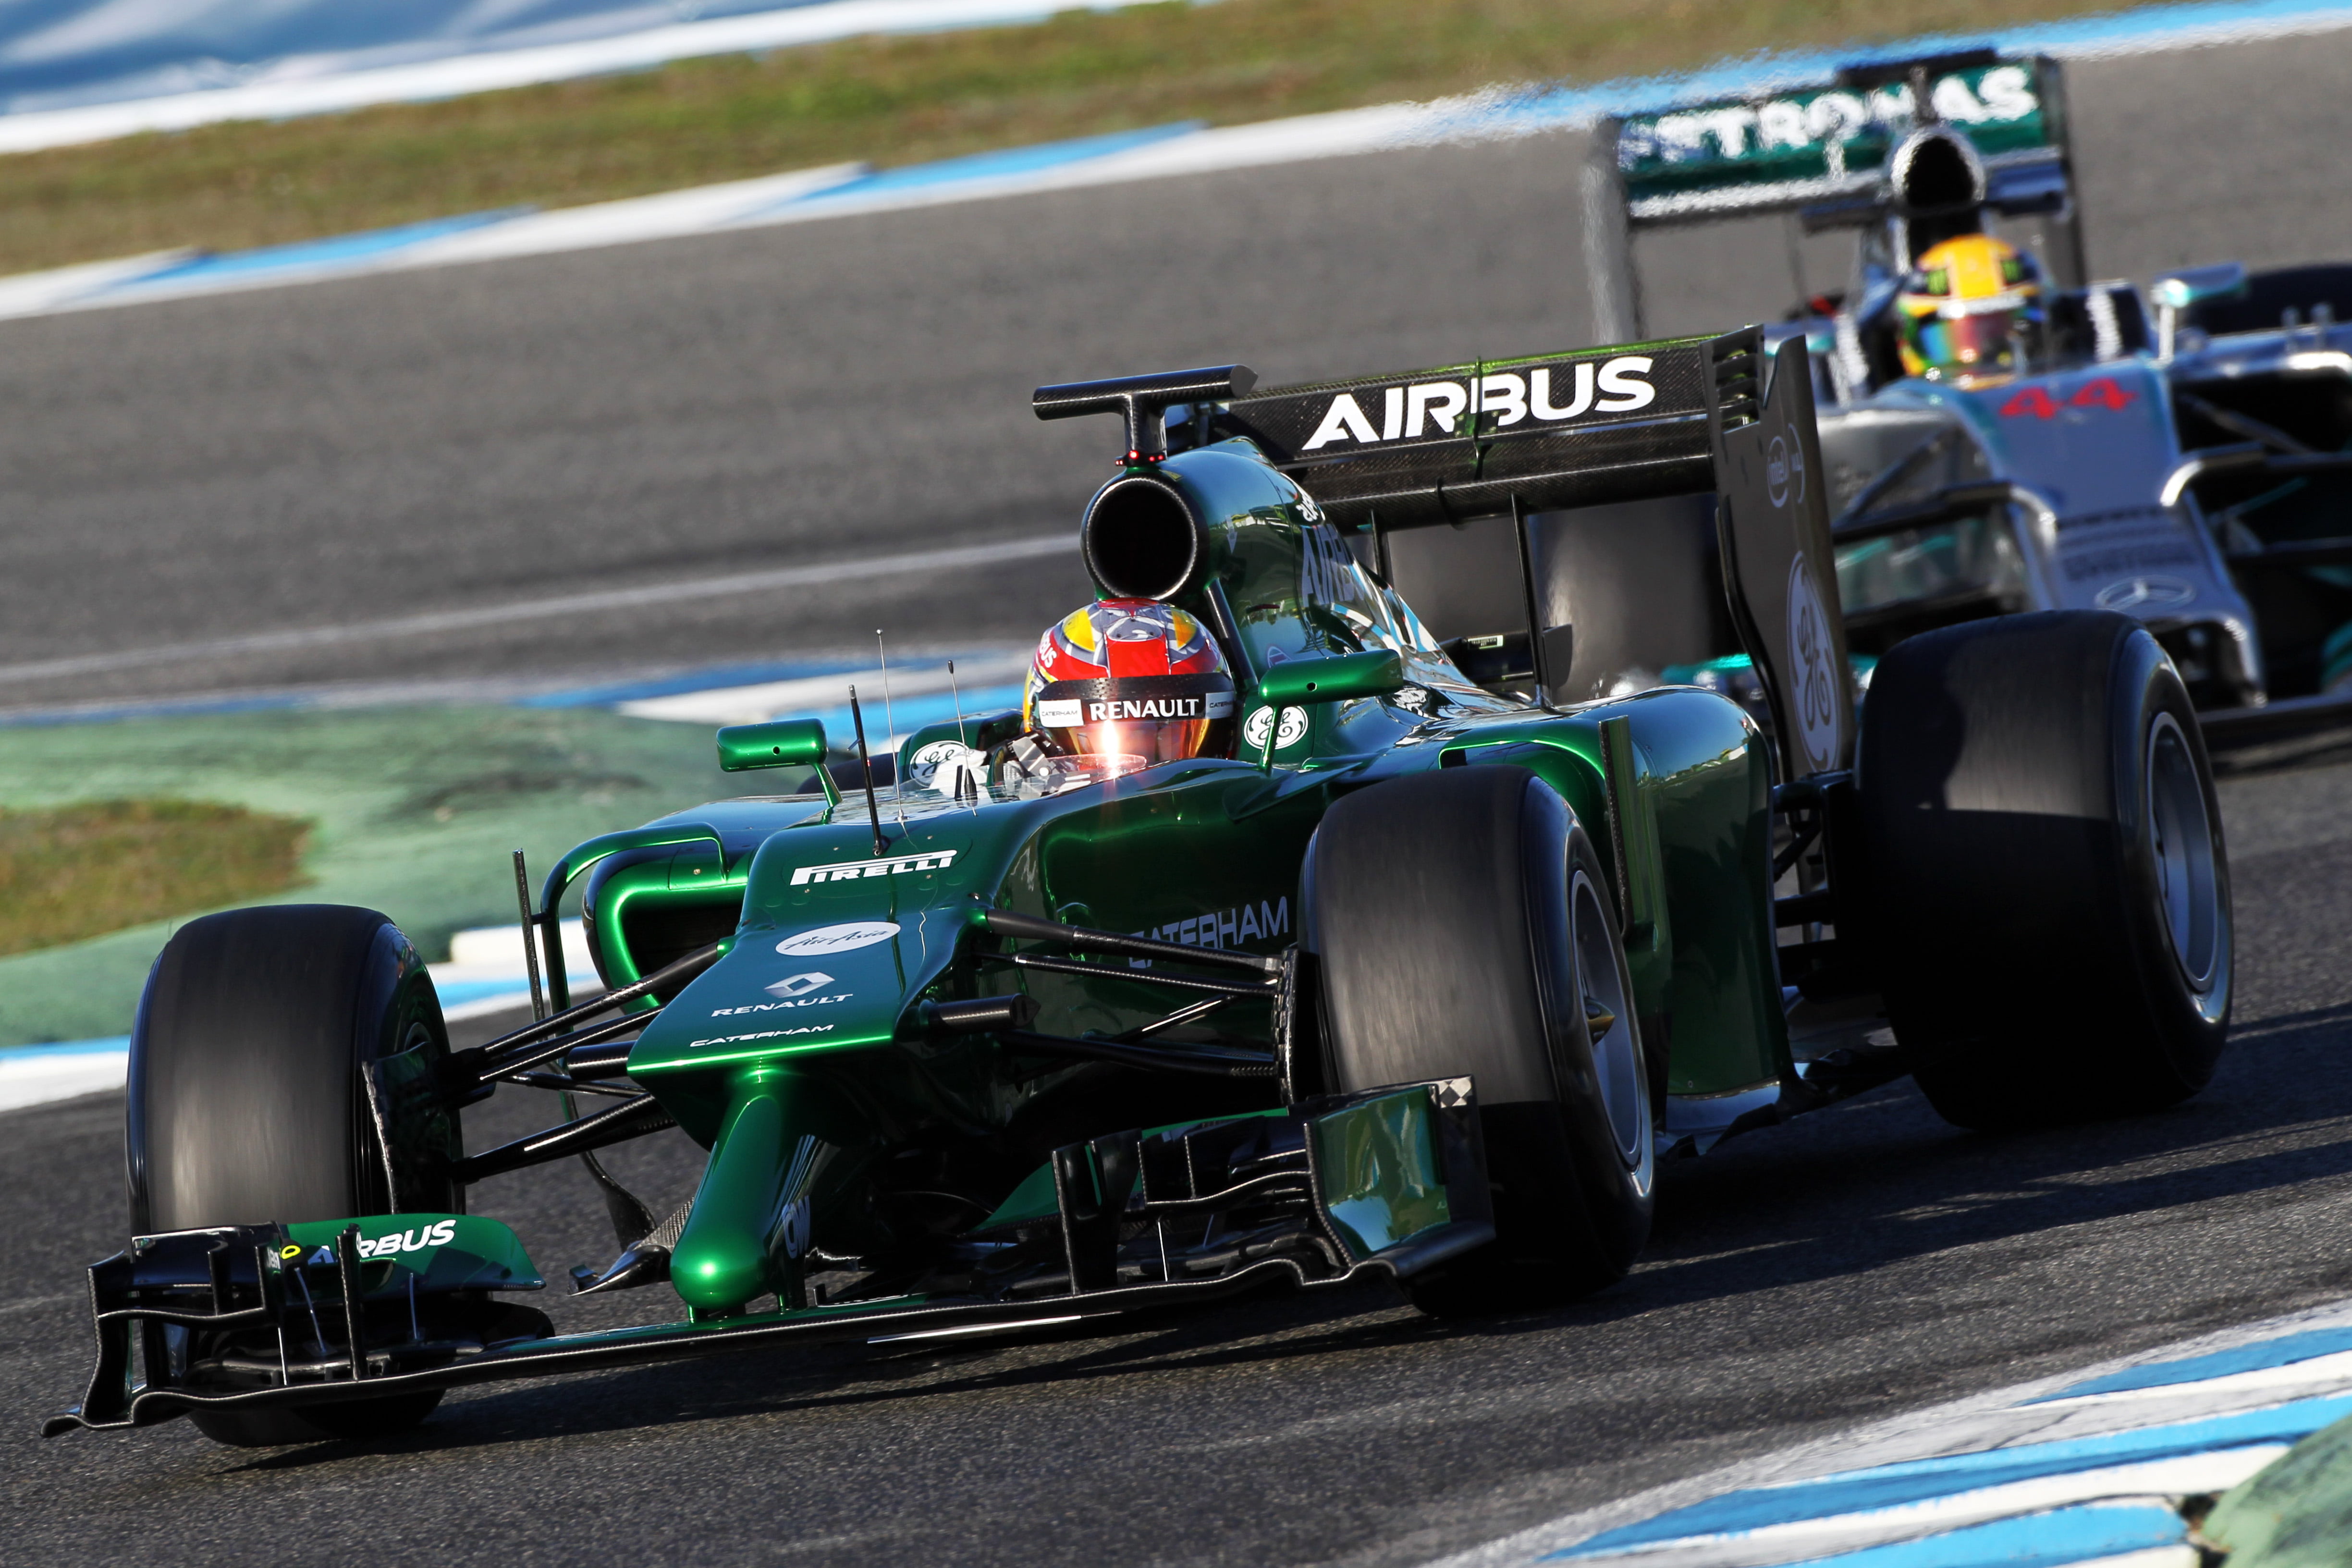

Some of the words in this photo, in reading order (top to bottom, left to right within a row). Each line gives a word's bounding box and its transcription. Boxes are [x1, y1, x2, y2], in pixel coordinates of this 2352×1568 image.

[1301, 356, 1655, 451] AIRBUS
[1999, 378, 2137, 420] 44
[1089, 698, 1199, 721] RENAULT
[789, 849, 957, 886] PIRELLI
[711, 993, 854, 1017] RENAULT
[689, 1024, 834, 1048] CATERHAM
[308, 1219, 457, 1265] ARBUS
